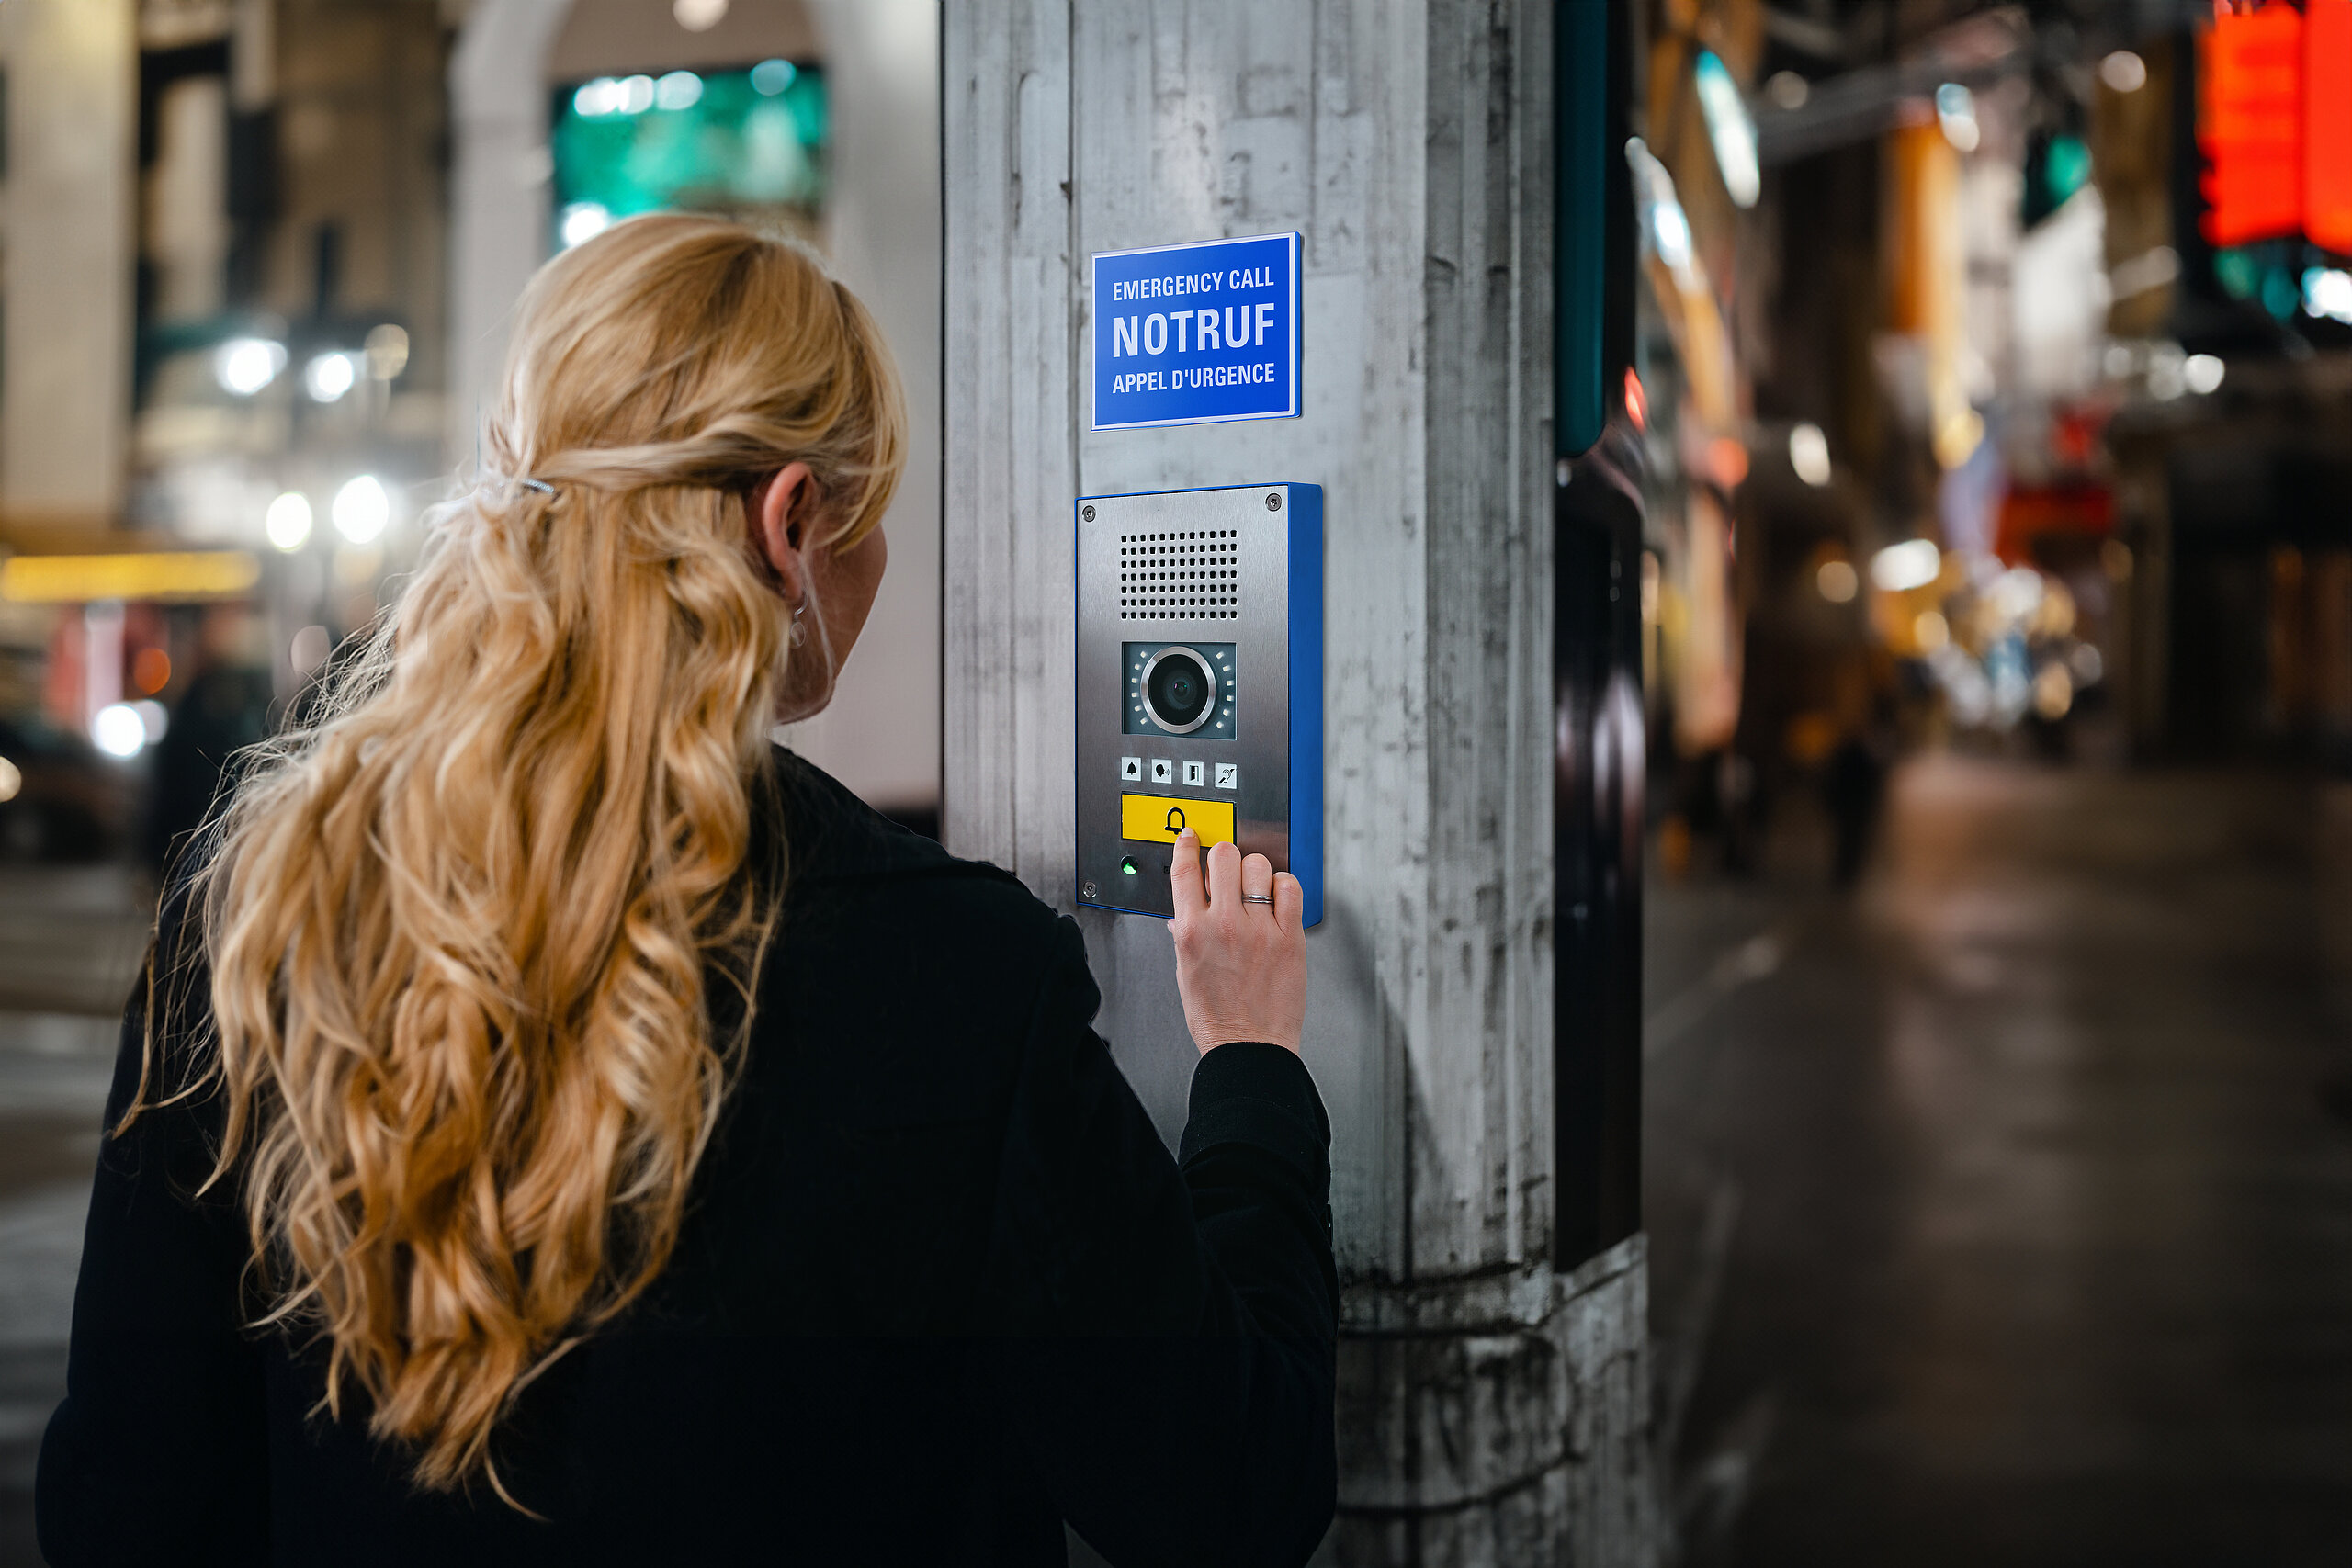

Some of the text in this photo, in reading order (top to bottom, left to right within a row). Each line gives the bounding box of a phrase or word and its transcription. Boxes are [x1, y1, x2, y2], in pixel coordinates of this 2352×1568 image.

[1113, 266, 1274, 301] EMERGENCY CALL
[1113, 302, 1274, 358] NOTRUF
[1112, 362, 1274, 394] APPEL D'URGENCE
